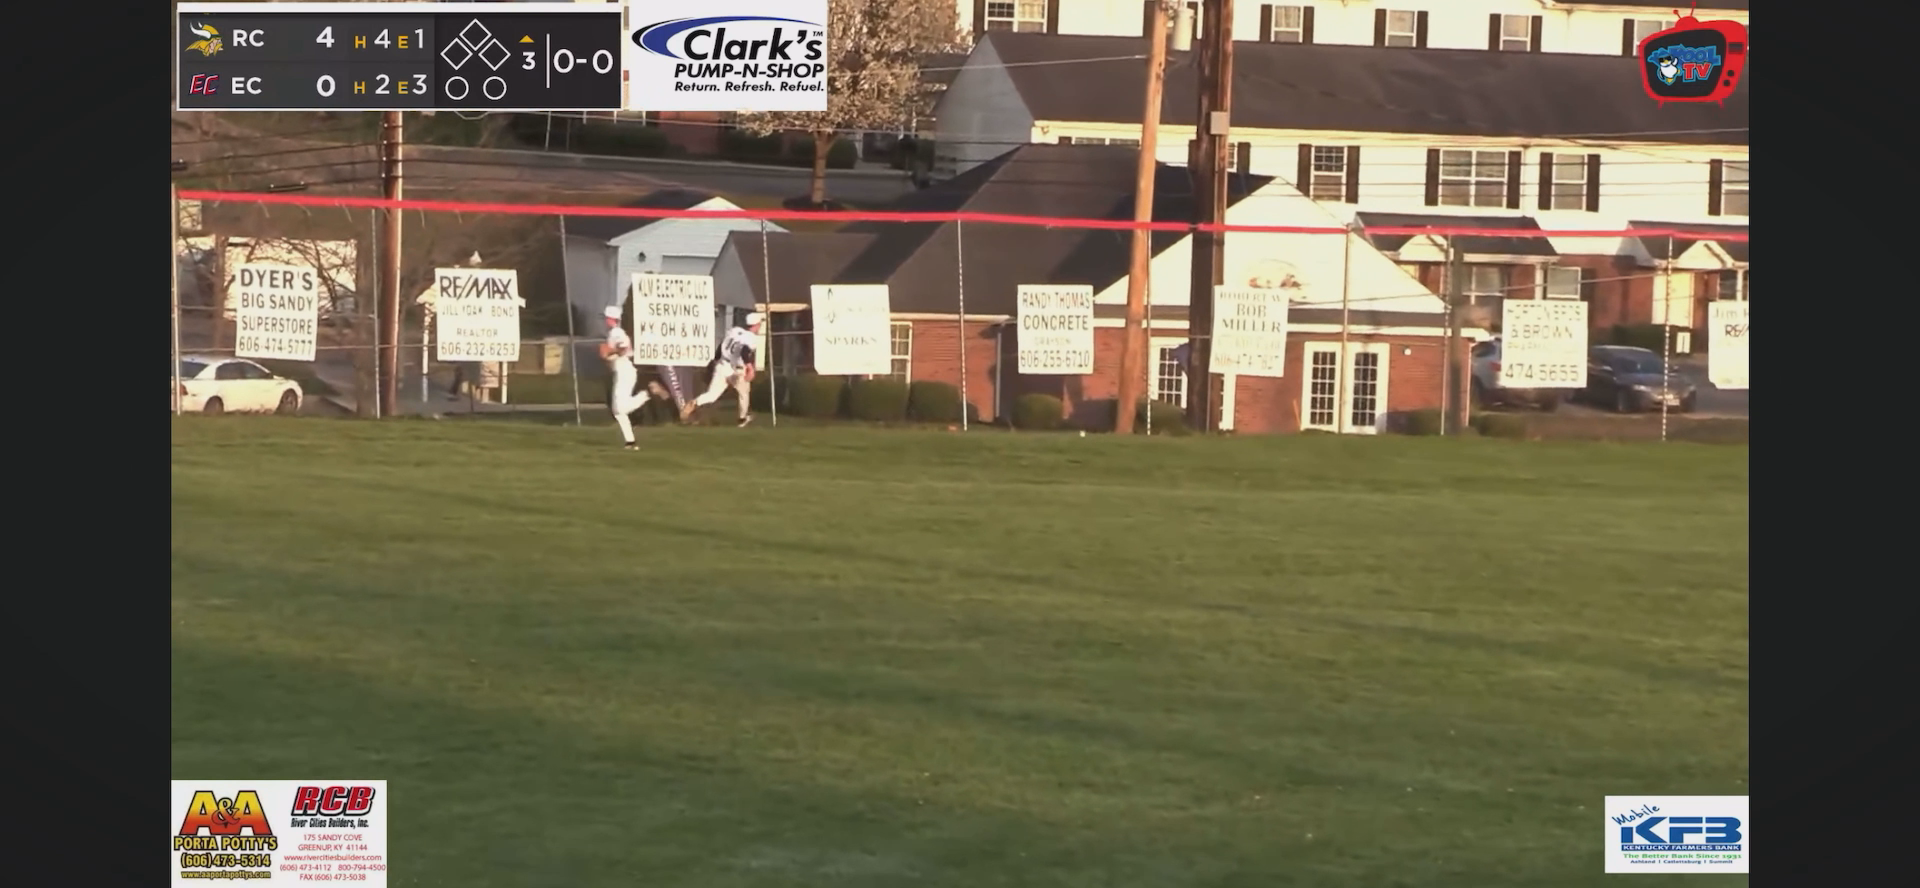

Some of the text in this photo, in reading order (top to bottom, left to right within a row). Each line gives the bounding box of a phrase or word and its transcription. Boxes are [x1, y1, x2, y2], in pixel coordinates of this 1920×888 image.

[240, 268, 313, 291] DYER'S
[440, 274, 512, 300] RE/MAX
[242, 292, 313, 311] BIG SANDY
[1022, 292, 1090, 309] RANDY THOMAS
[649, 303, 699, 317] SERVING
[1237, 303, 1266, 317] BOB
[242, 315, 312, 335] SUPERSTORE
[661, 322, 676, 337] OH
[681, 323, 687, 337] &
[692, 324, 708, 338] WV
[1023, 315, 1089, 331] CONCRETE
[1222, 318, 1281, 332] MILLER
[457, 328, 498, 337] REALTOR
[239, 336, 312, 355] 606-474-5777
[441, 342, 515, 356] 606-232-6253
